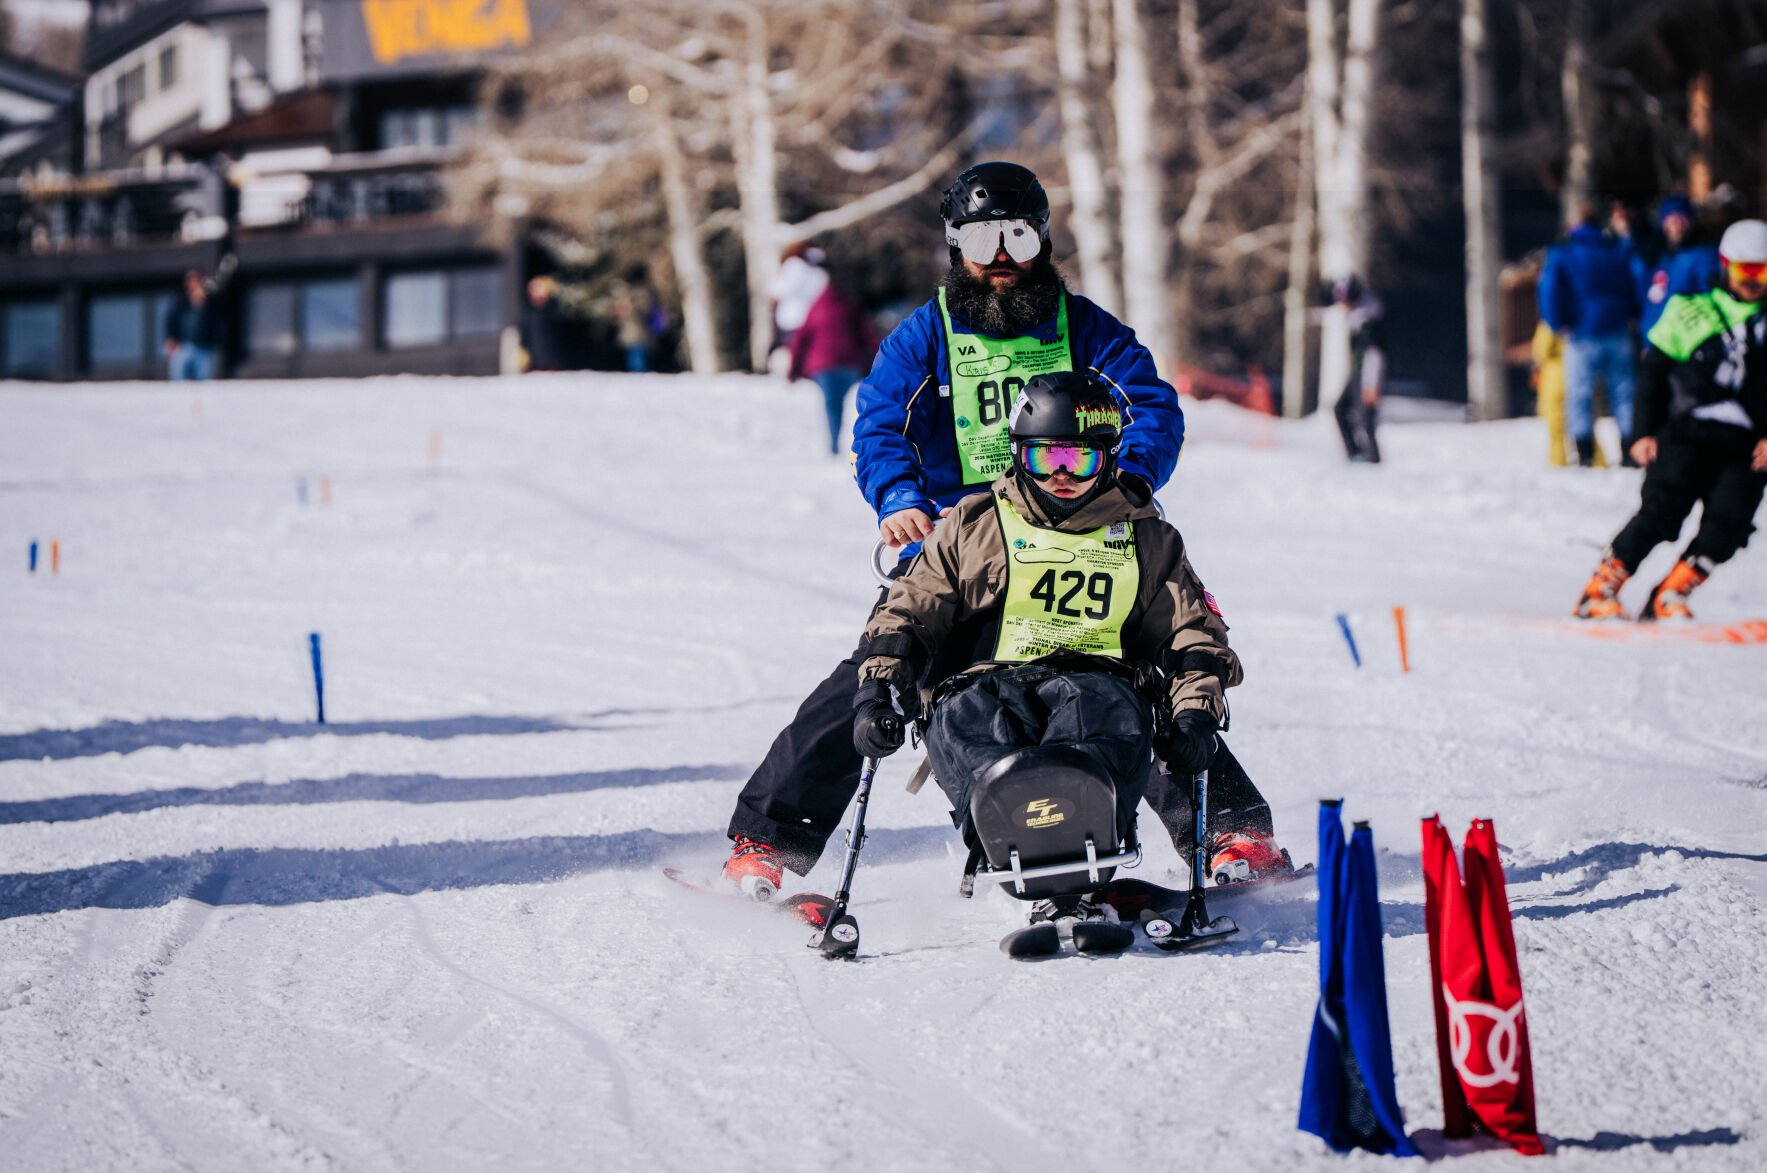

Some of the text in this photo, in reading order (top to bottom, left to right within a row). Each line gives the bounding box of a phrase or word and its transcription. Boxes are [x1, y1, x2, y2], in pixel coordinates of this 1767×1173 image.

[958, 345, 976, 356] VA
[981, 463, 1006, 475] ASPEN
[1030, 568, 1114, 620] 429
